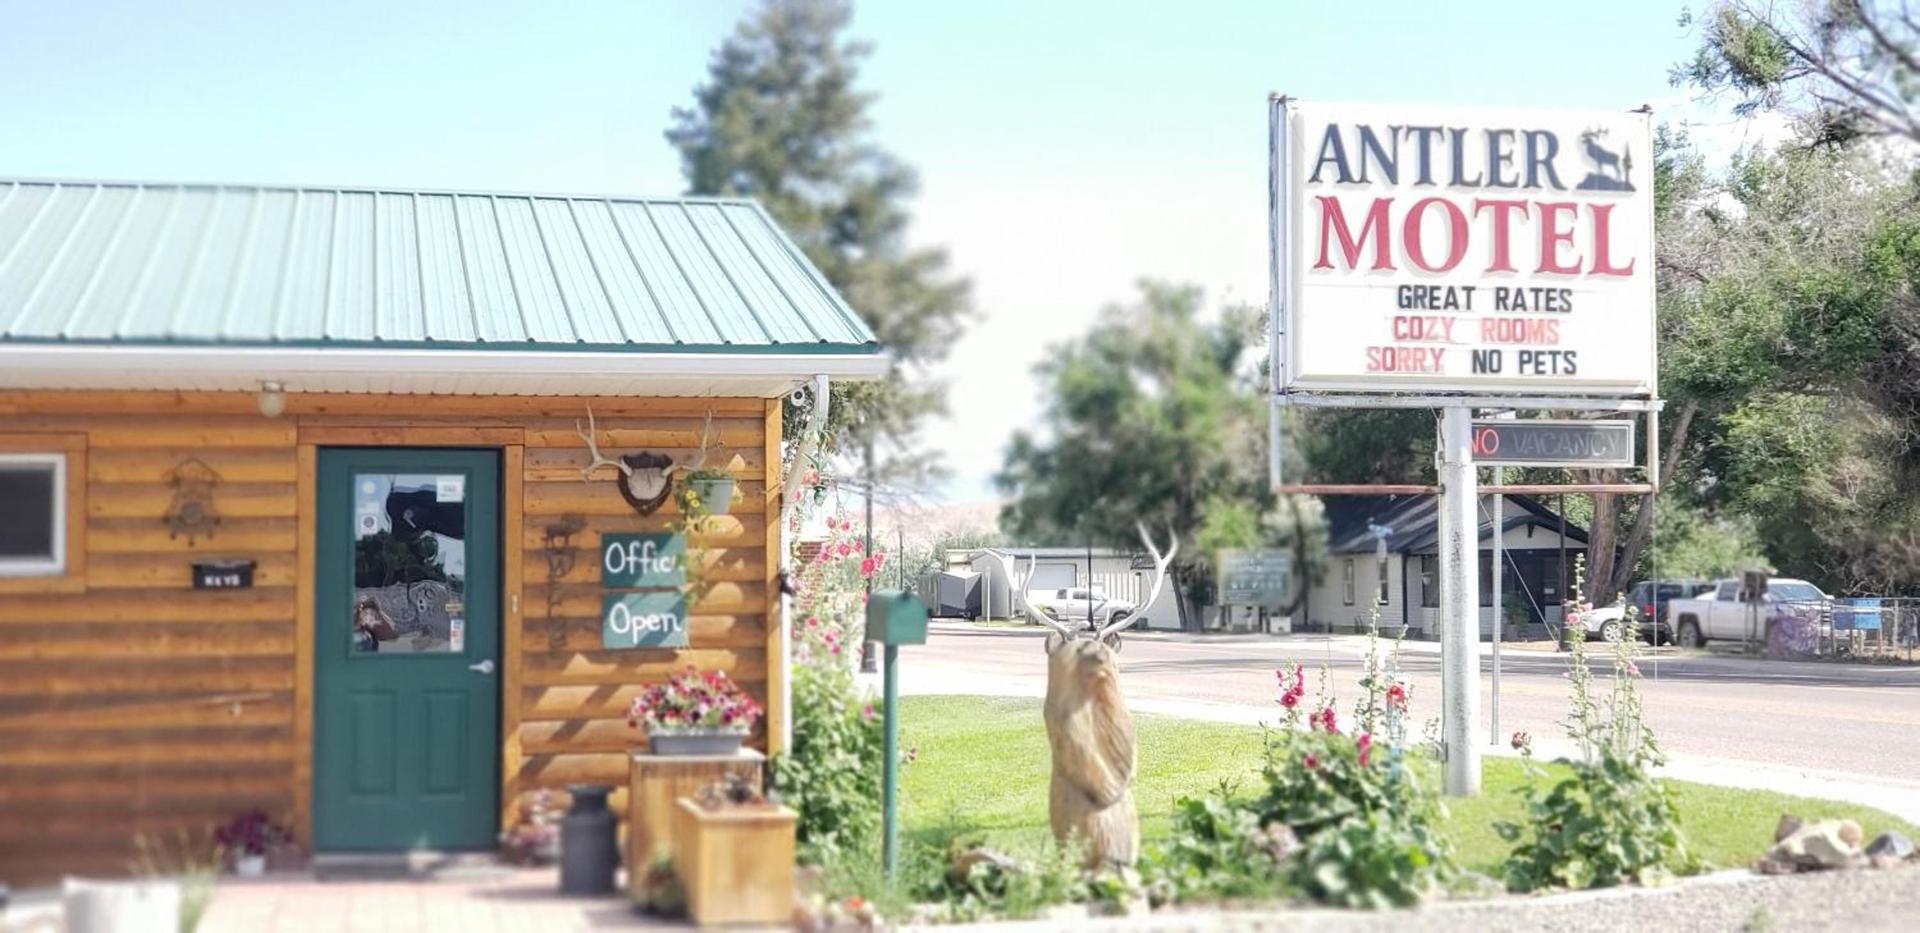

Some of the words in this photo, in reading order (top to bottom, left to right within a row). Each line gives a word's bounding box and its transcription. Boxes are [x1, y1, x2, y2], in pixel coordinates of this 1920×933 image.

[1308, 122, 1568, 191] ANTLER
[1312, 195, 1636, 277] MOTEL
[1397, 284, 1476, 310] GREAT
[1495, 286, 1573, 314] RATES
[1392, 315, 1456, 342] COZY
[1480, 317, 1560, 345] ROOMS
[1366, 345, 1446, 373] SORRY
[1471, 349, 1503, 375] NO
[1518, 350, 1577, 376] PETS
[1512, 430, 1621, 457] VACANCY
[609, 602, 683, 645] Open
